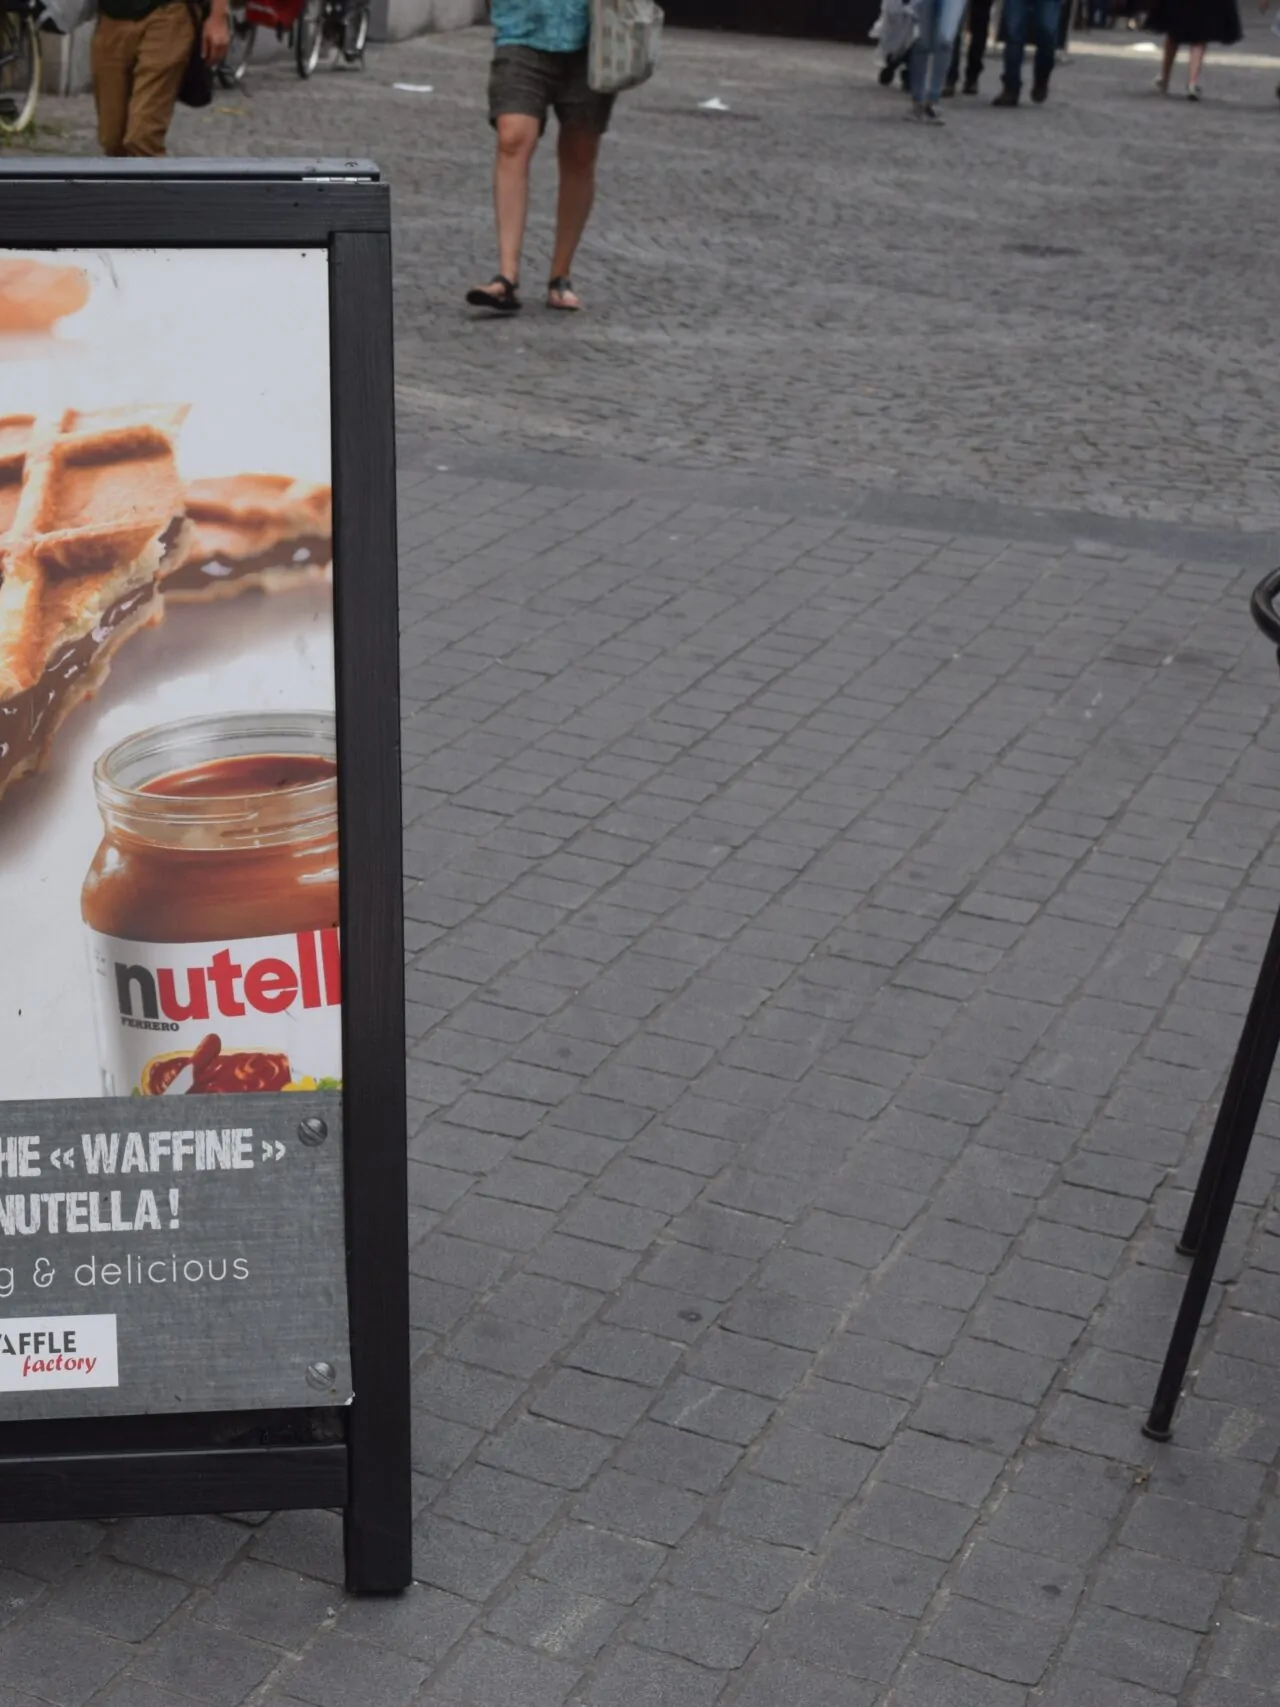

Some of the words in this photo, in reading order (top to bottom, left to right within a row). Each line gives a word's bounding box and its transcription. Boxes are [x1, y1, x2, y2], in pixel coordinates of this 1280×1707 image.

[121, 1018, 180, 1031] FERRERO
[82, 1128, 254, 1175] WAFFINE
[33, 1257, 55, 1287] &
[75, 1253, 250, 1287] delicious
[22, 1353, 97, 1377] factory
